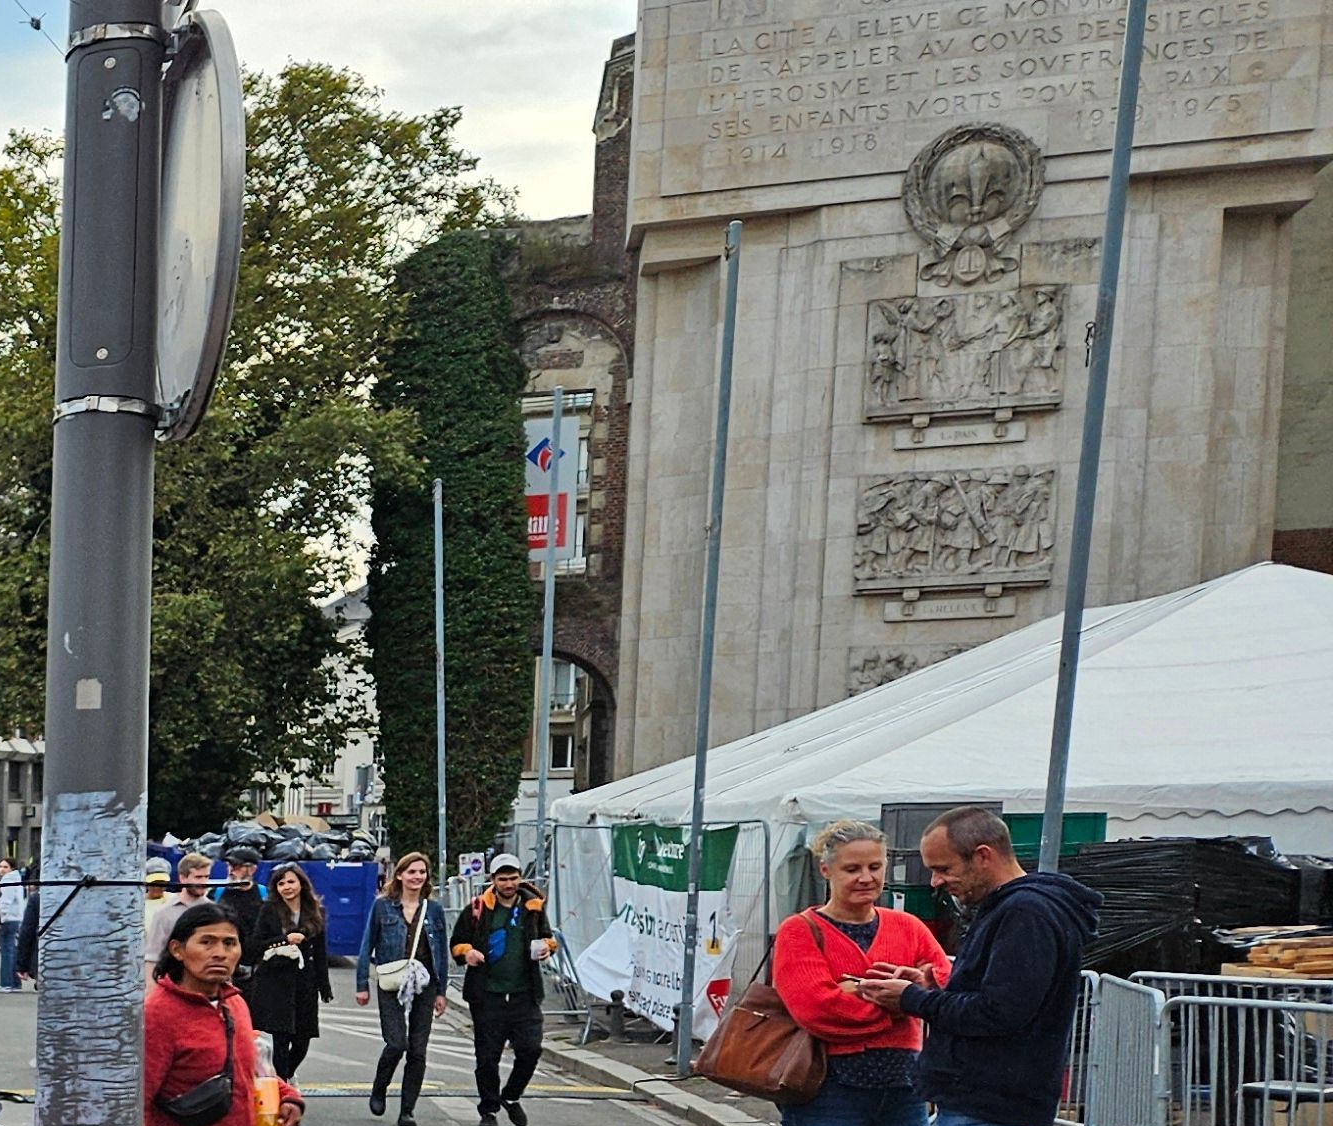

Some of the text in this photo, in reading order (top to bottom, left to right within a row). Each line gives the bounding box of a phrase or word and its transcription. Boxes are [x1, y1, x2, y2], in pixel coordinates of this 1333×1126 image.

[710, 64, 741, 84] DE
[762, 45, 902, 77] RAPPELER
[971, 25, 1063, 52] COVRS
[1078, 18, 1127, 41] DES
[1145, 1, 1270, 33] SIECLES
[712, 37, 746, 56] LA
[755, 28, 815, 50] CITE
[825, 26, 845, 42] A
[857, 12, 941, 39] ELEVE
[886, 72, 919, 92] ET
[935, 64, 982, 86] LES
[1000, 37, 1215, 79] SOVFFRNCES
[1235, 31, 1268, 51] DE
[708, 118, 753, 140] SES
[770, 103, 889, 132] ENFANTS
